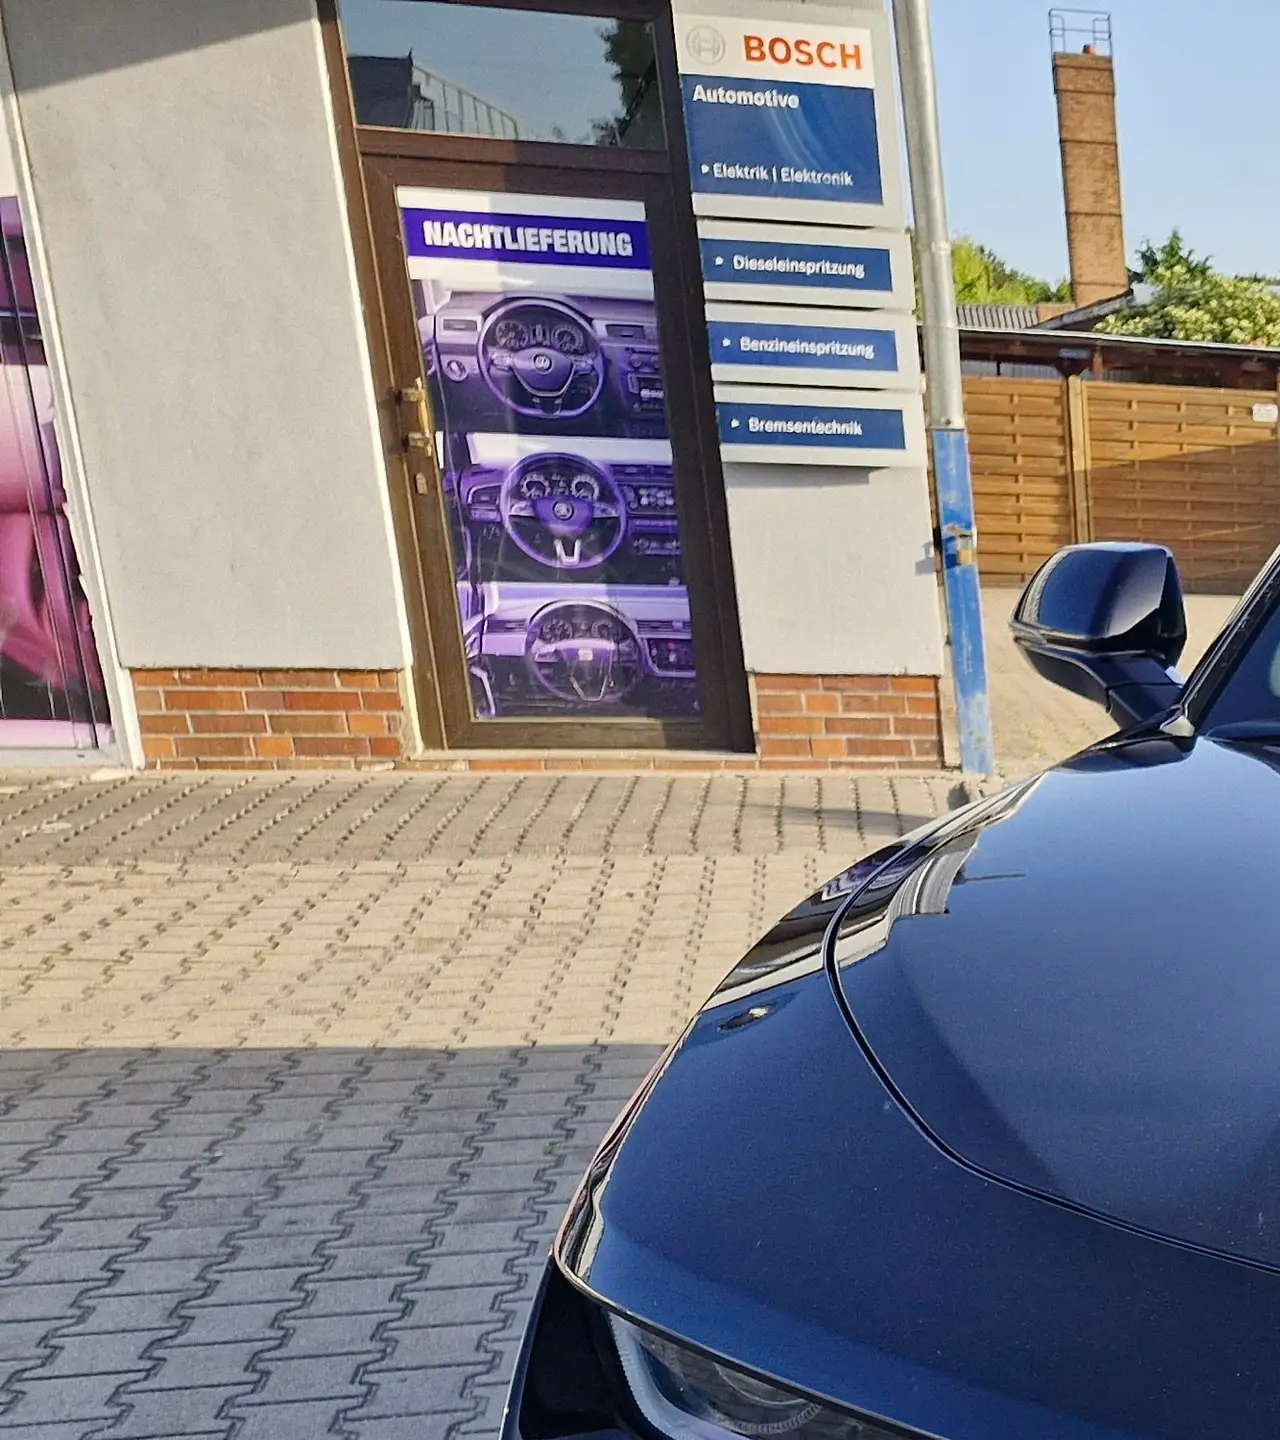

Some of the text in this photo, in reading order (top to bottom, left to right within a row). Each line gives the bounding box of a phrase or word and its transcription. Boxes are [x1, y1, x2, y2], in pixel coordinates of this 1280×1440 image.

[743, 35, 862, 70] BOSCH
[693, 84, 800, 109] Automotive
[713, 162, 768, 182] Elektrik
[781, 168, 853, 187] Elektronik
[423, 220, 633, 257] NACHTLIEFERUNG
[733, 254, 865, 279] Dieseleinspritzung
[740, 336, 875, 360] Benzineinspritzung
[749, 417, 862, 436] Bremsentechnik
